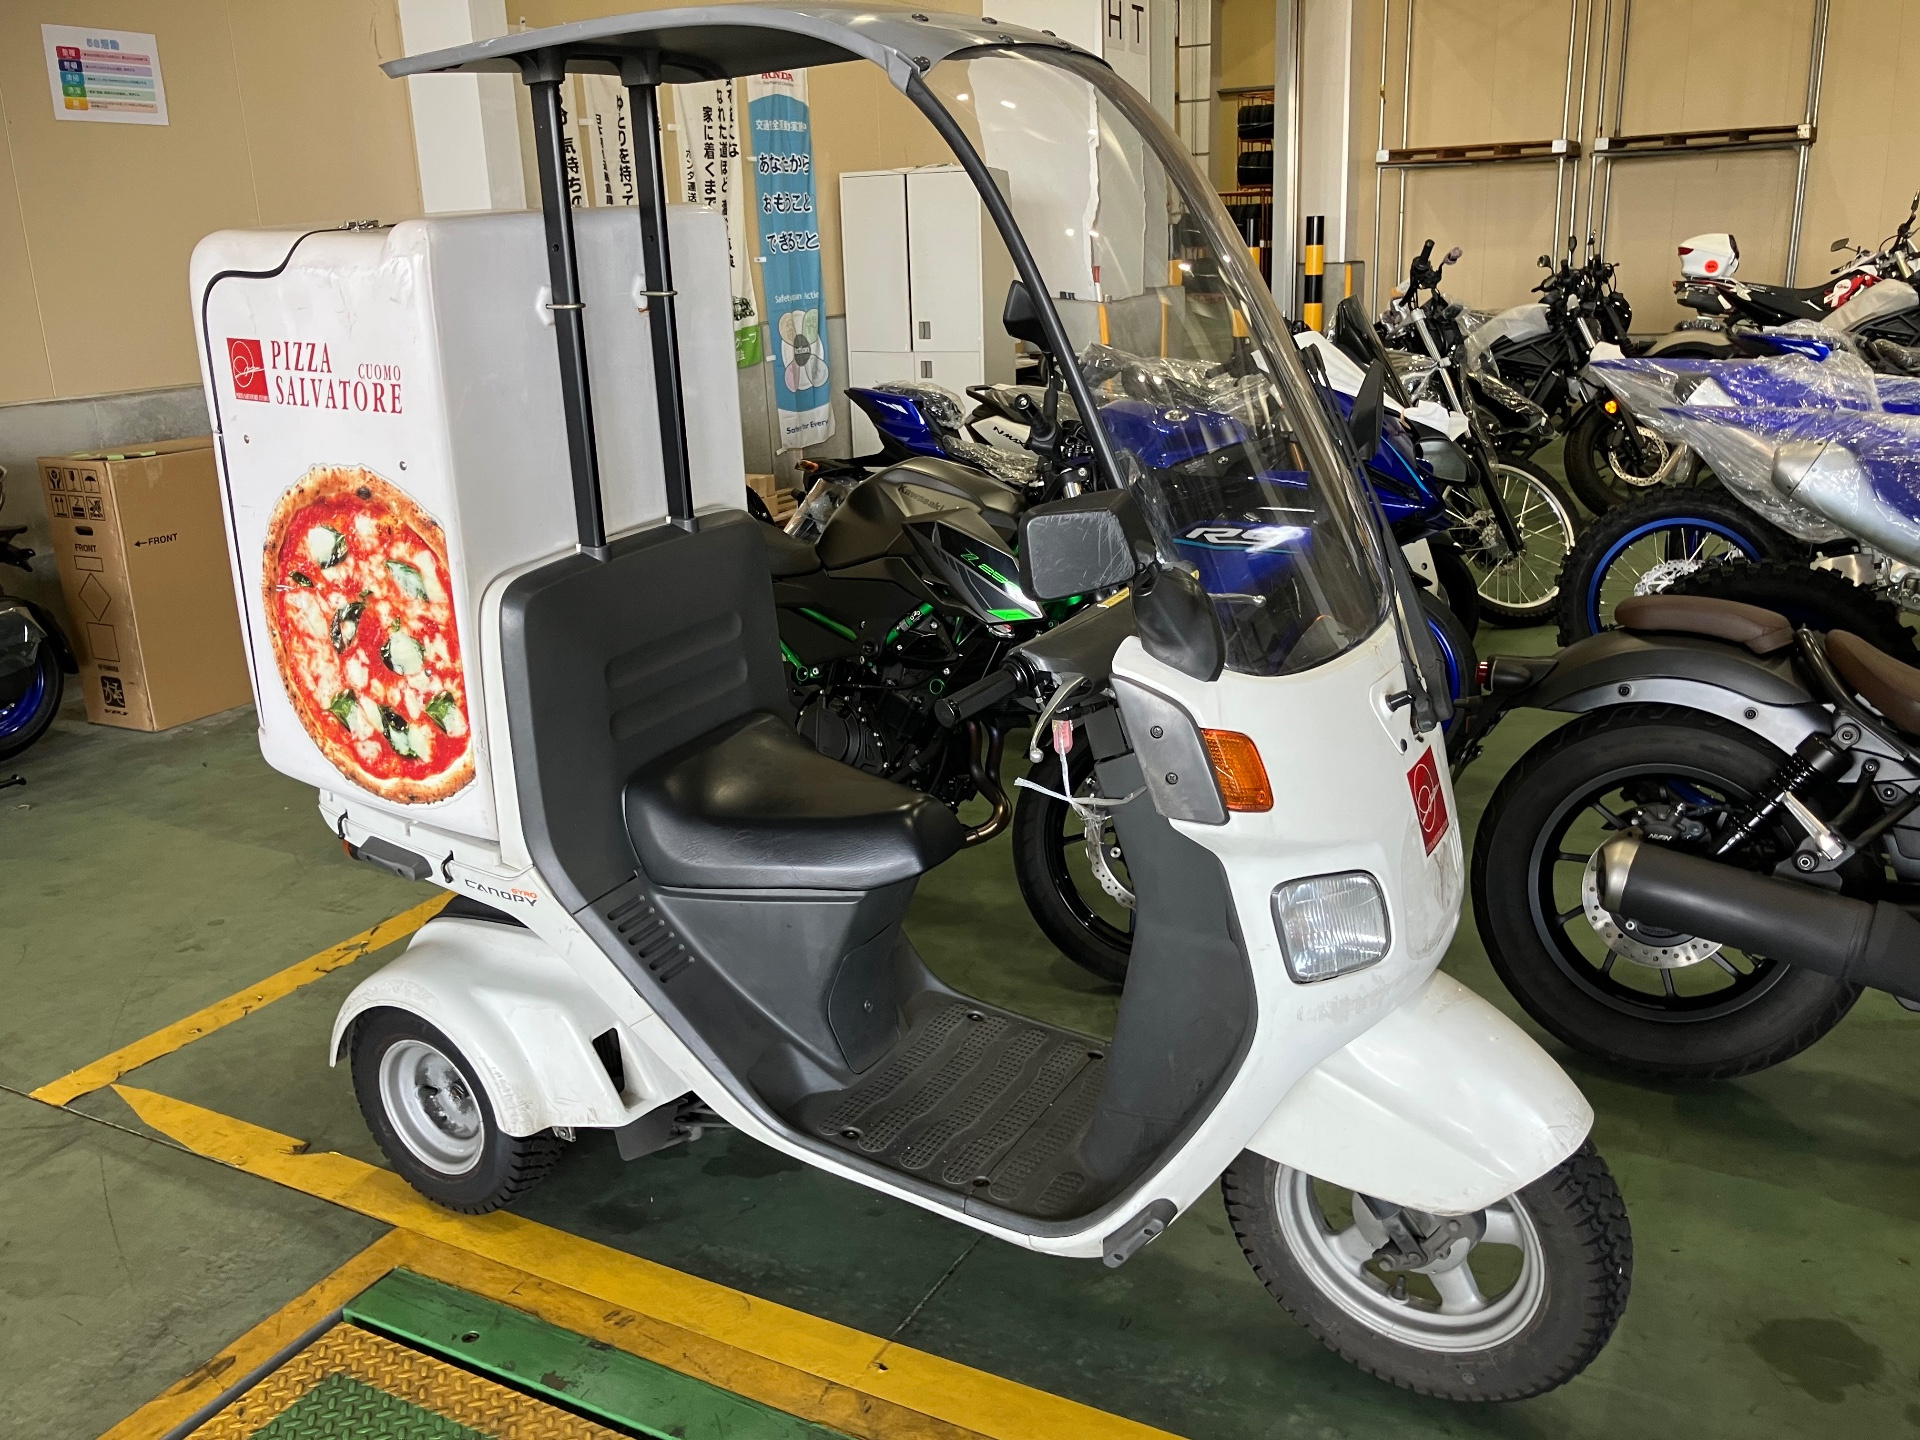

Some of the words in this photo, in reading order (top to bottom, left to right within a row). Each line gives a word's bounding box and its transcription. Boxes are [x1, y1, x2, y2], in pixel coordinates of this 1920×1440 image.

[702, 106, 717, 207] 家に着くまで
[763, 192, 813, 214] おもうこと
[766, 230, 819, 254] できること
[270, 340, 333, 374] PIZZA
[358, 363, 402, 381] CUOMO
[276, 375, 403, 415] SALVATORE
[897, 482, 946, 512] Kawasaki
[74, 543, 97, 553] FRONT
[148, 532, 178, 545] FRONT
[464, 878, 538, 907] CANOPY
[511, 887, 538, 899] GYRO
